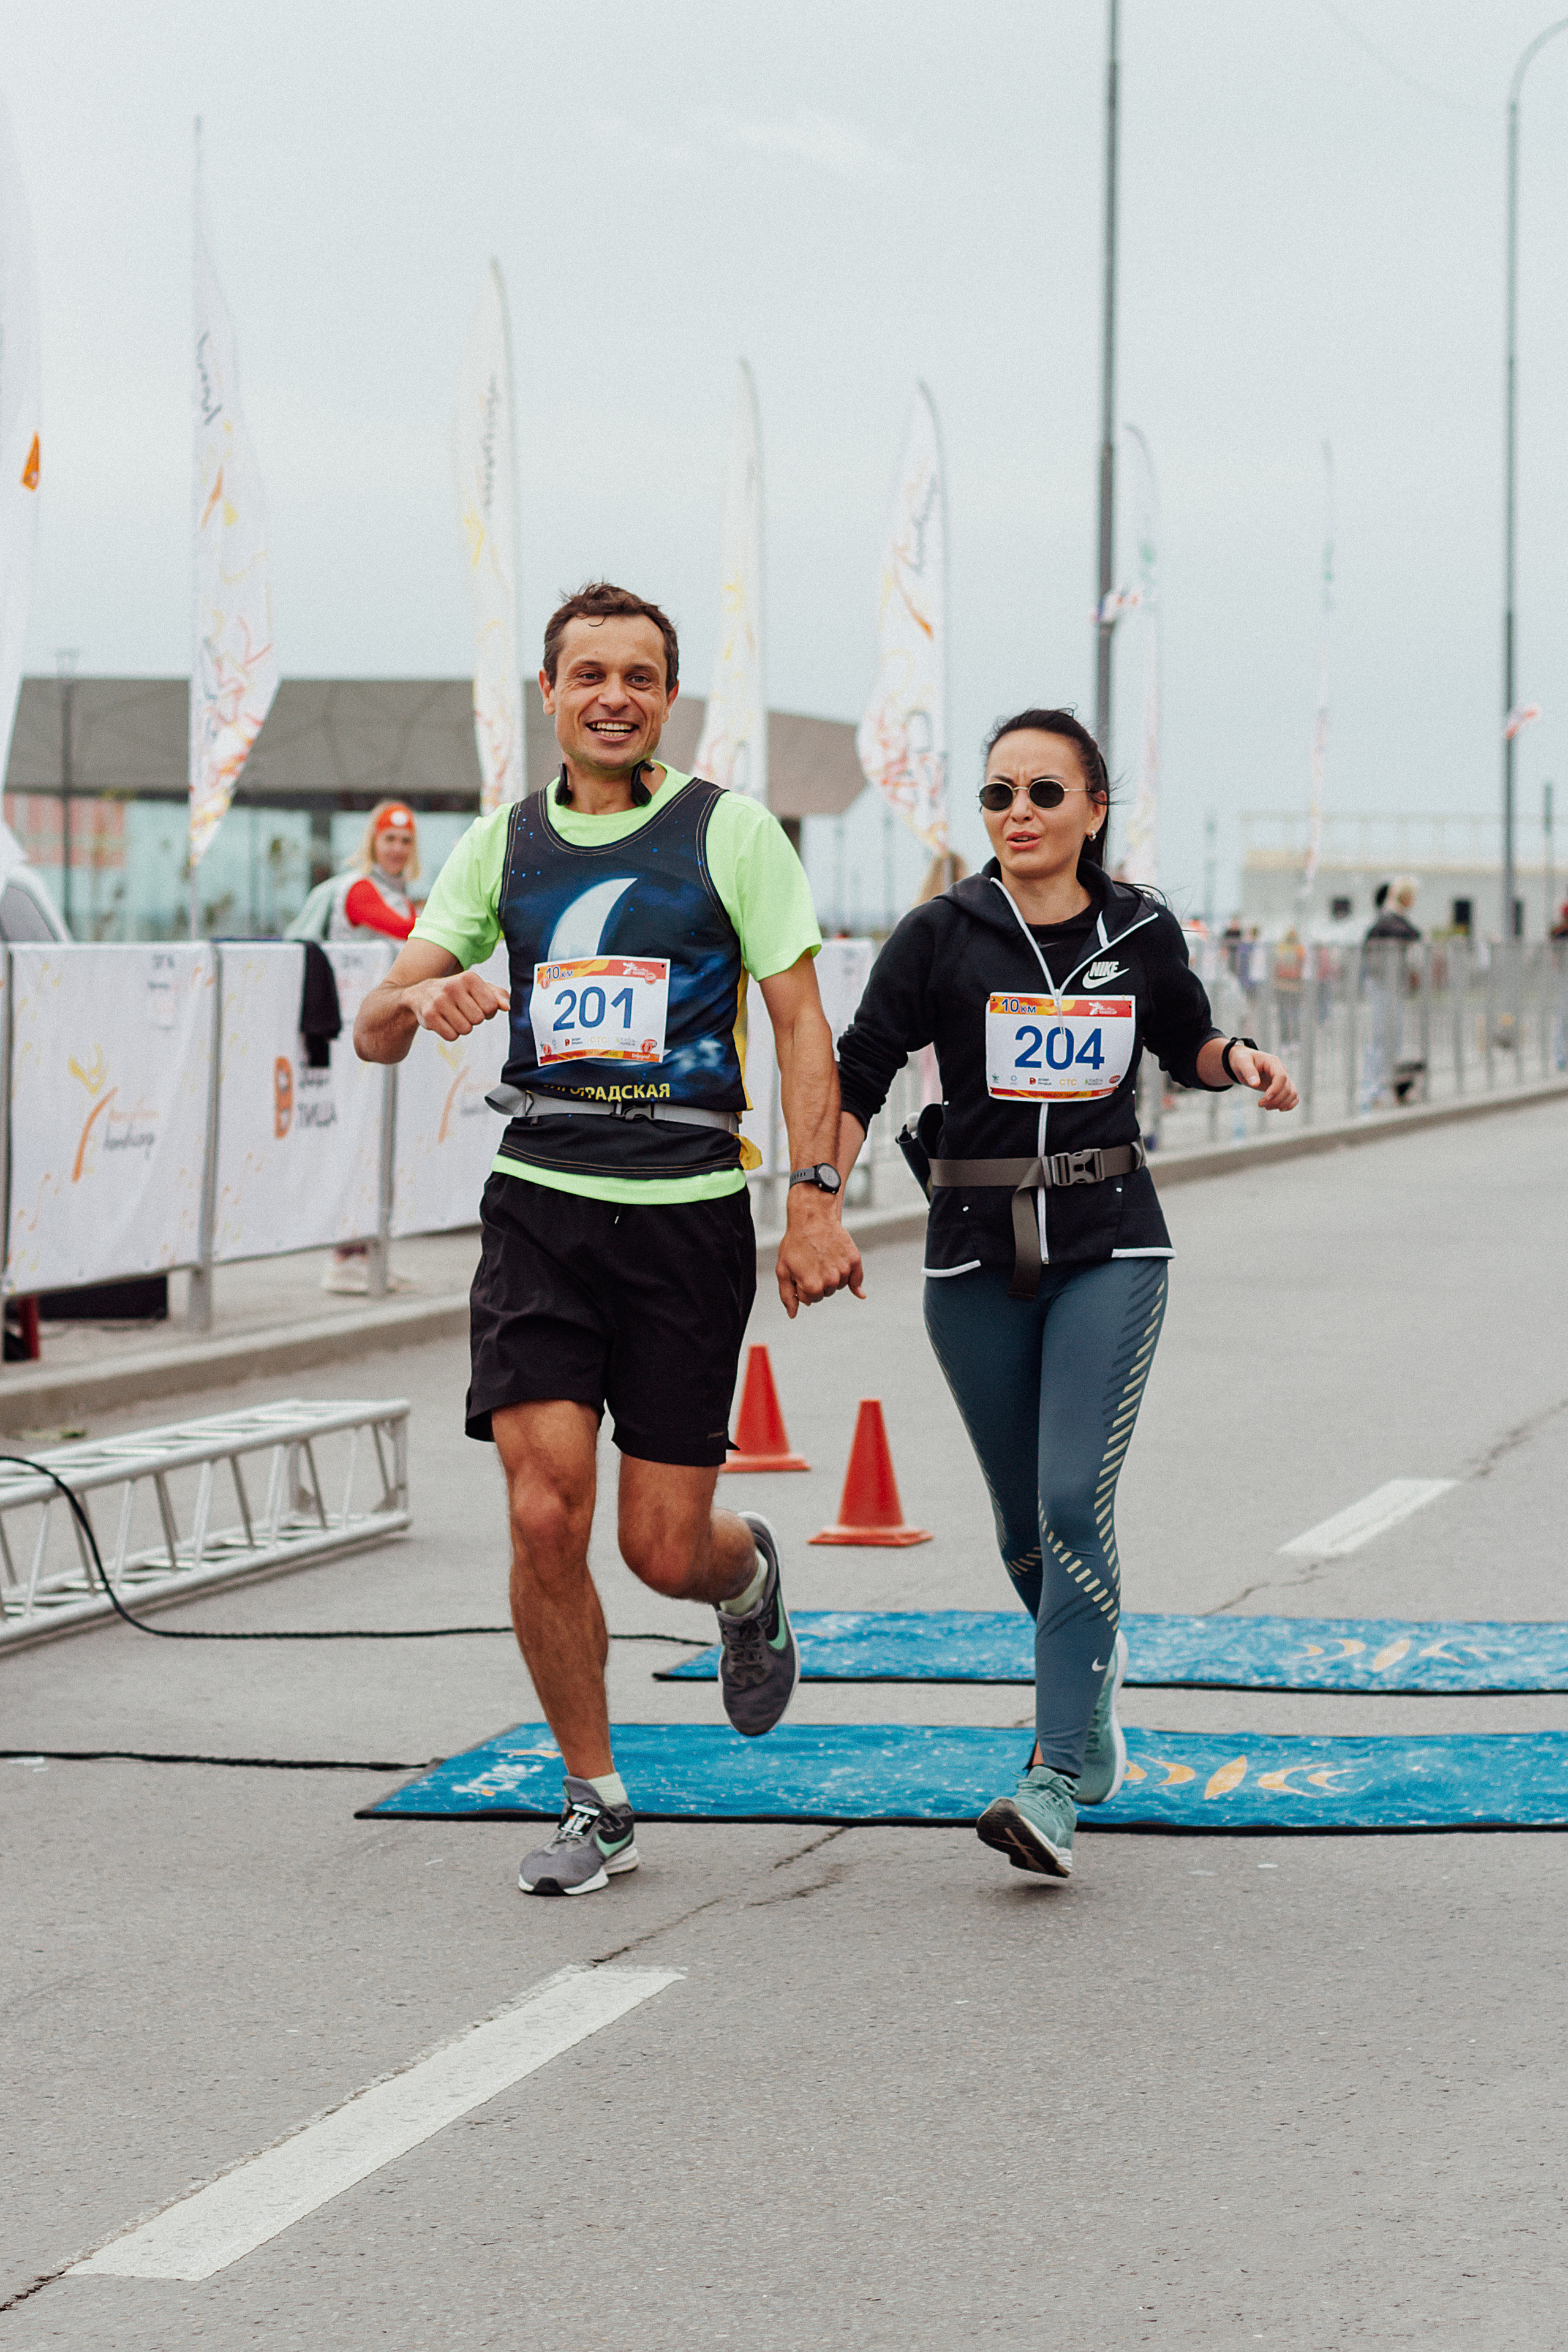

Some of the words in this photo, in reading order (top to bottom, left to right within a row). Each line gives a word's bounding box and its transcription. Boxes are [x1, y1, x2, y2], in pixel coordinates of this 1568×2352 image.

[1089, 961, 1119, 976] NIKE
[552, 987, 633, 1031] 201
[1015, 1026, 1104, 1070] 204
